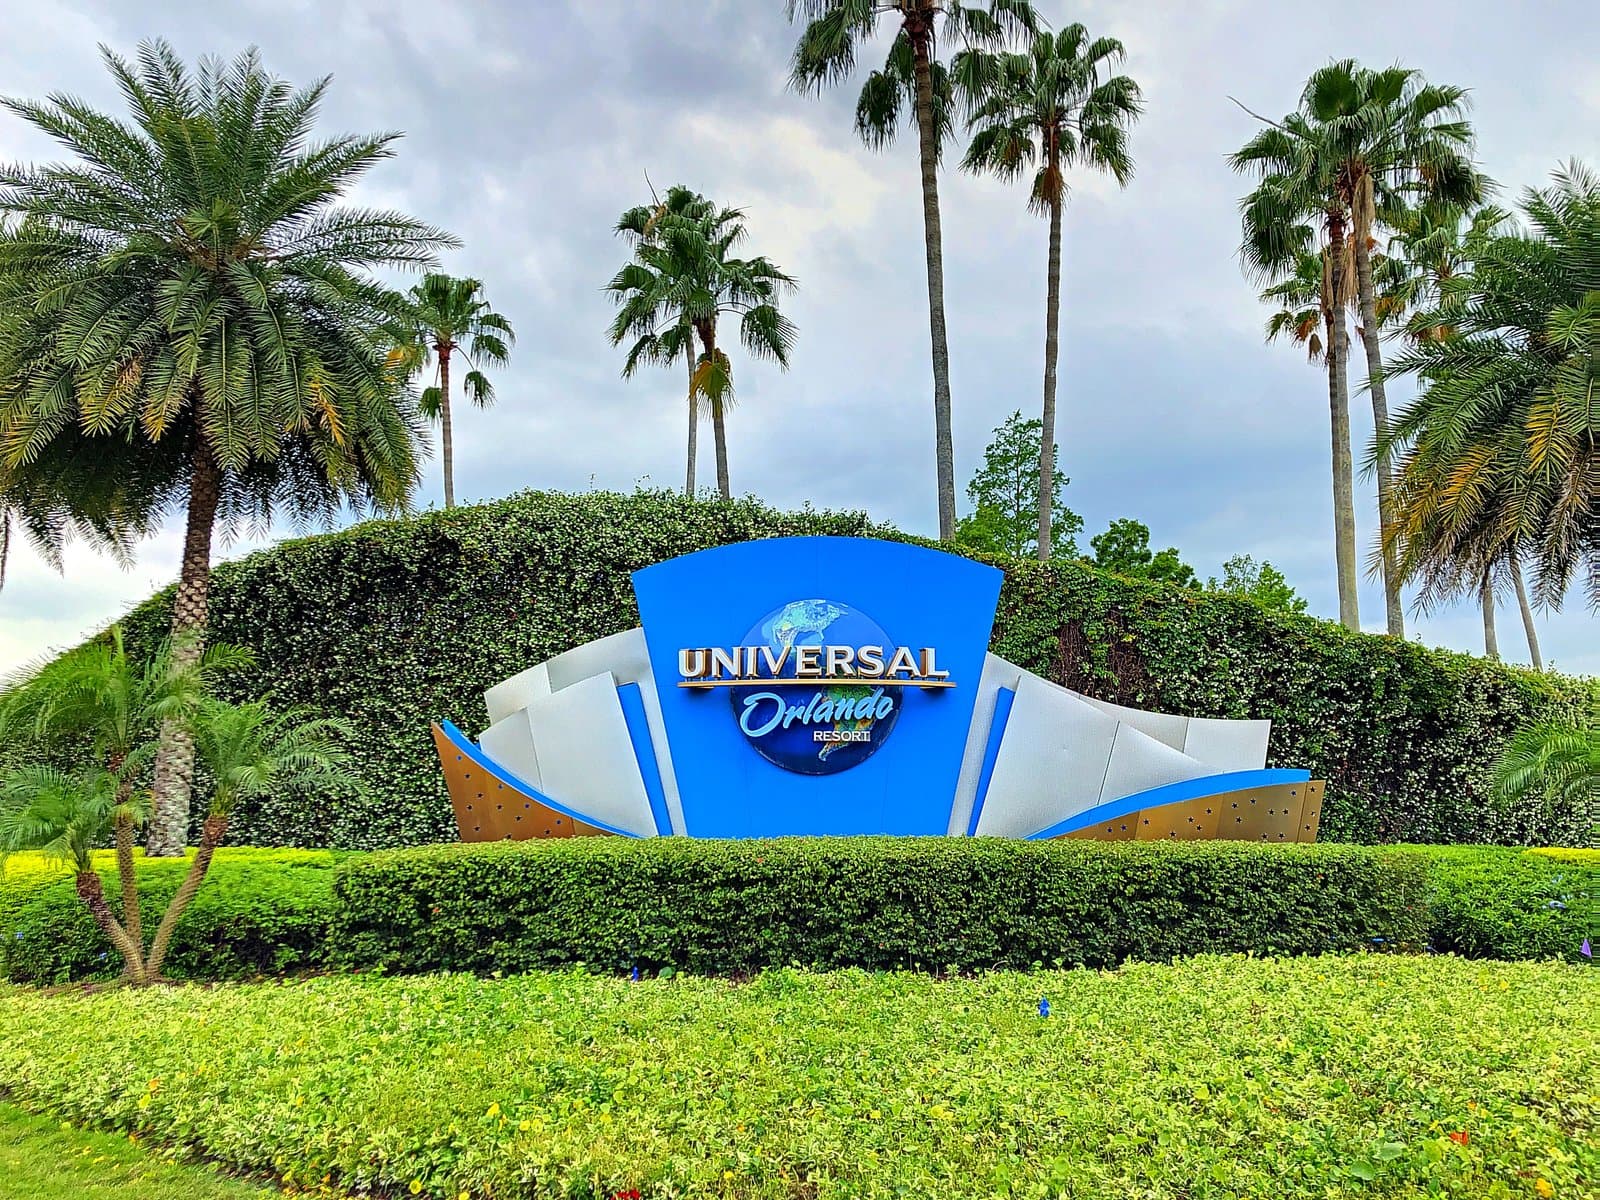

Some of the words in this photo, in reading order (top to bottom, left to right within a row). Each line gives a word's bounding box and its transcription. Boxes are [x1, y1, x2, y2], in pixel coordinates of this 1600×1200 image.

[678, 645, 950, 678] UNIVERSAL
[740, 688, 894, 737] Orlando
[813, 730, 871, 742] RESORT
